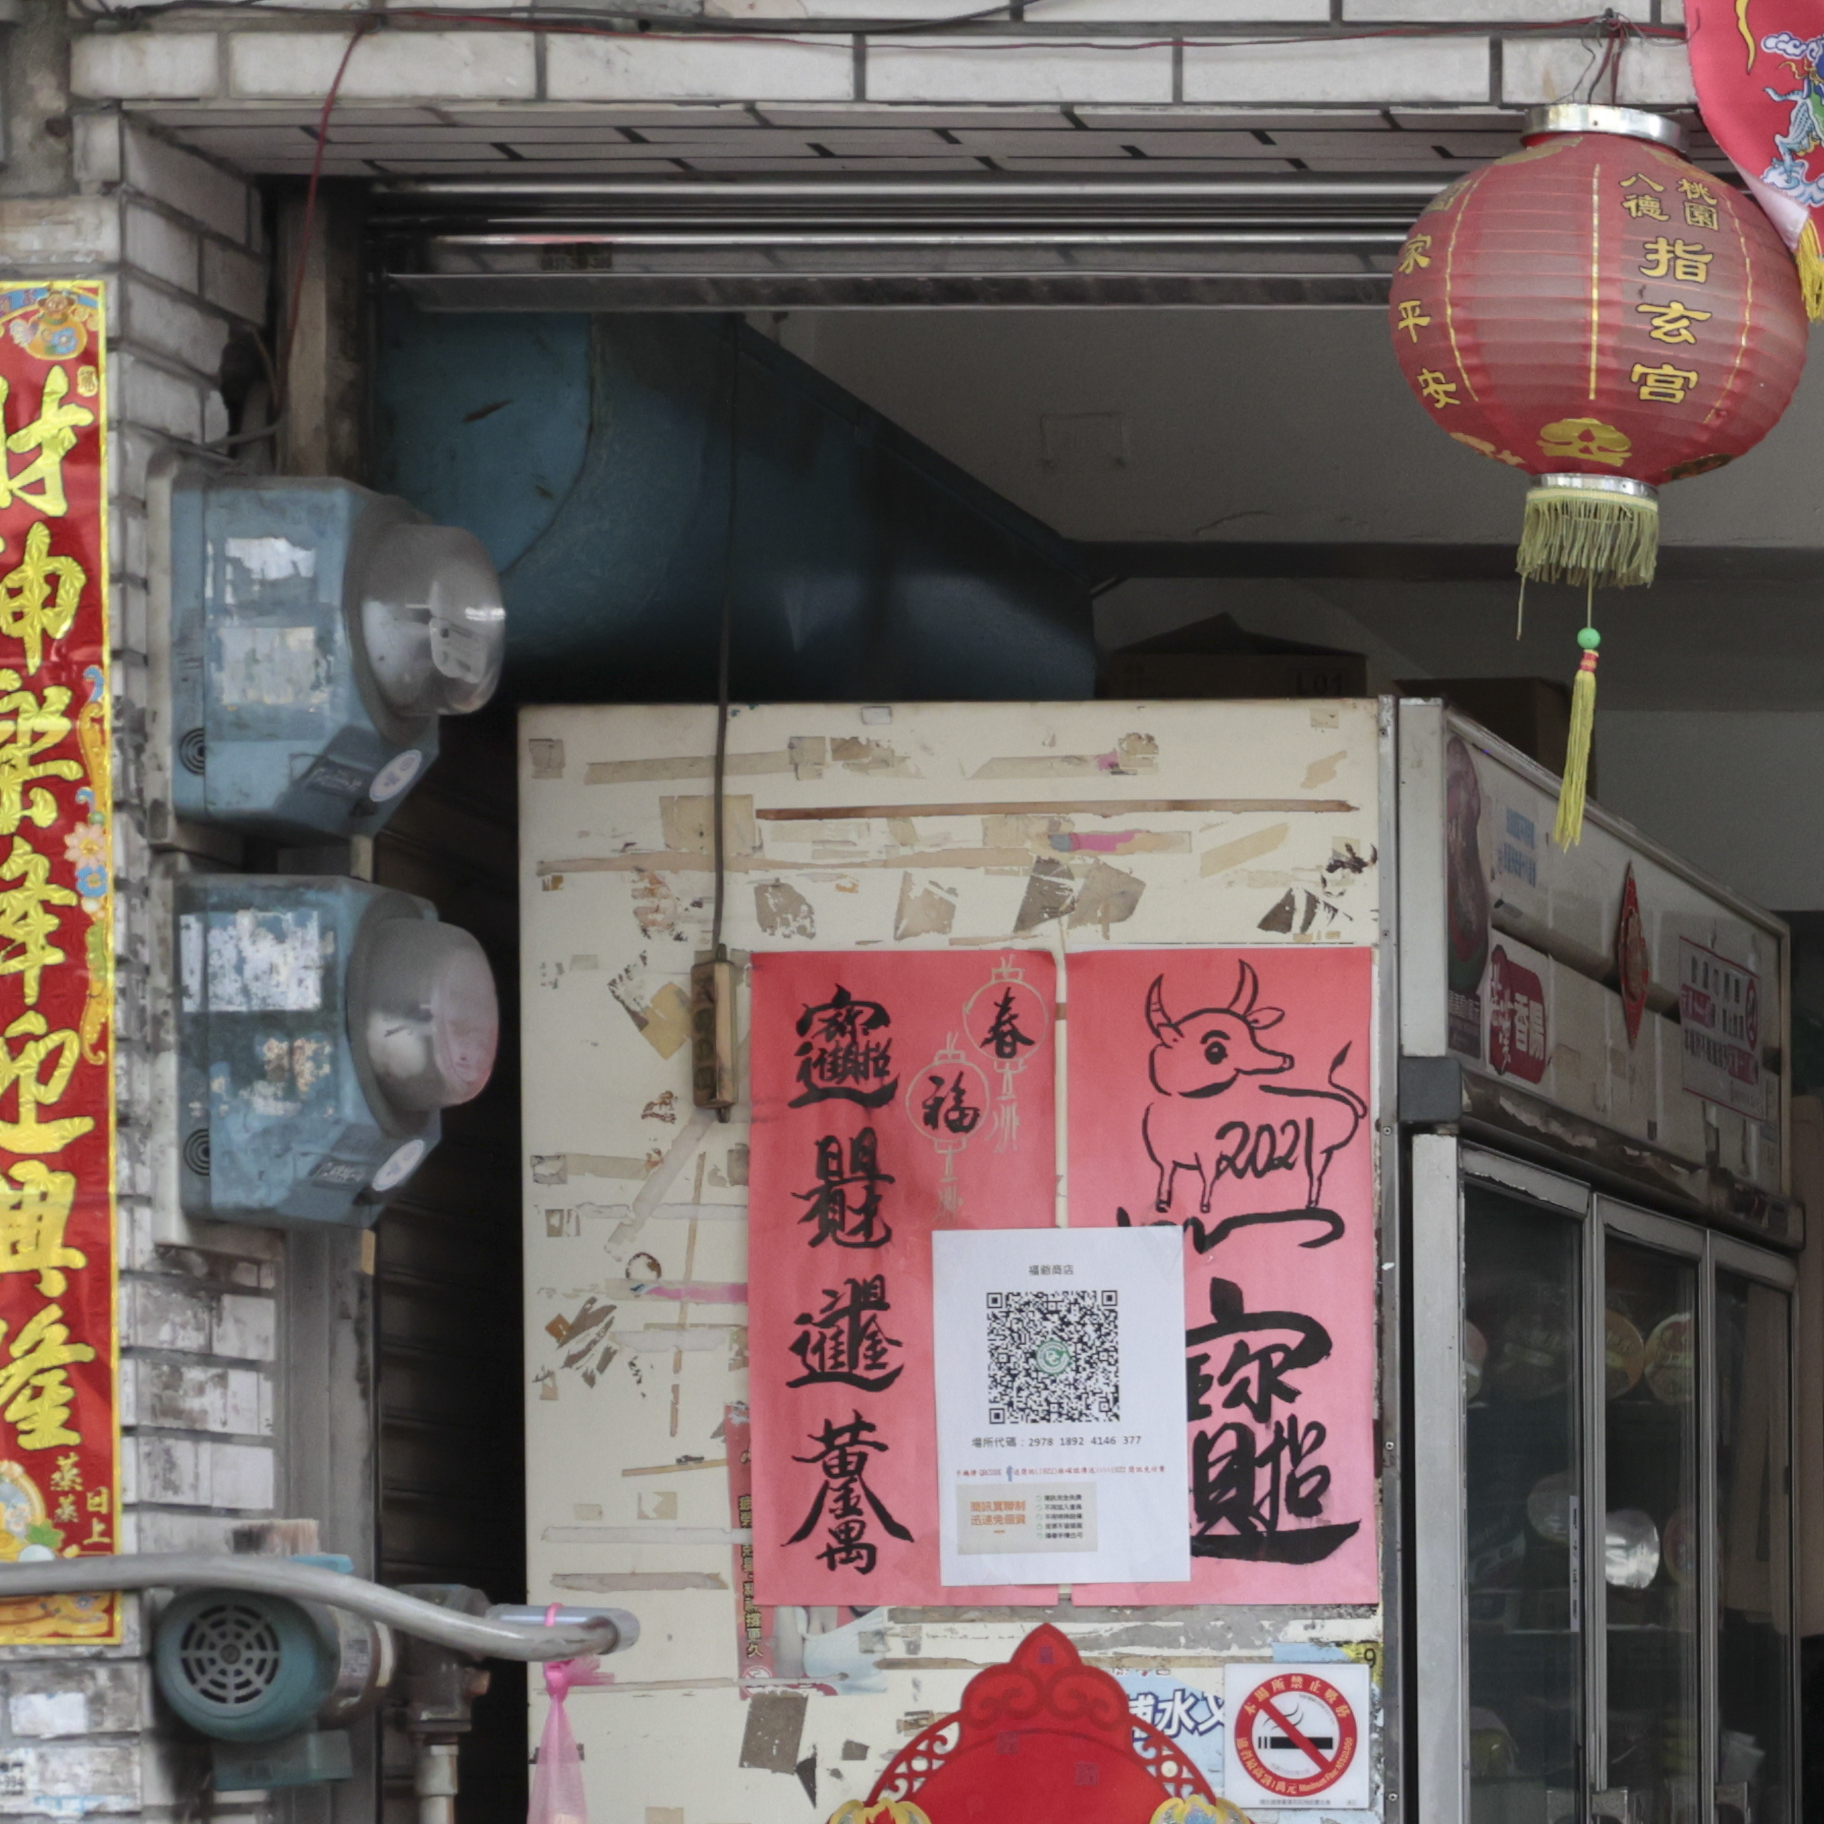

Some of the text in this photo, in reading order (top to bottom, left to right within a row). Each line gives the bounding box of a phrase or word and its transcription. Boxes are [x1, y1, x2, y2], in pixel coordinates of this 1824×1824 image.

[979, 985, 1036, 1061] 春
[921, 1071, 980, 1138] 福
[1214, 1116, 1320, 1190] 2021
[1059, 1436, 1085, 1447] 1892
[1090, 1435, 1117, 1446] 4146
[1122, 1434, 1142, 1446] 377
